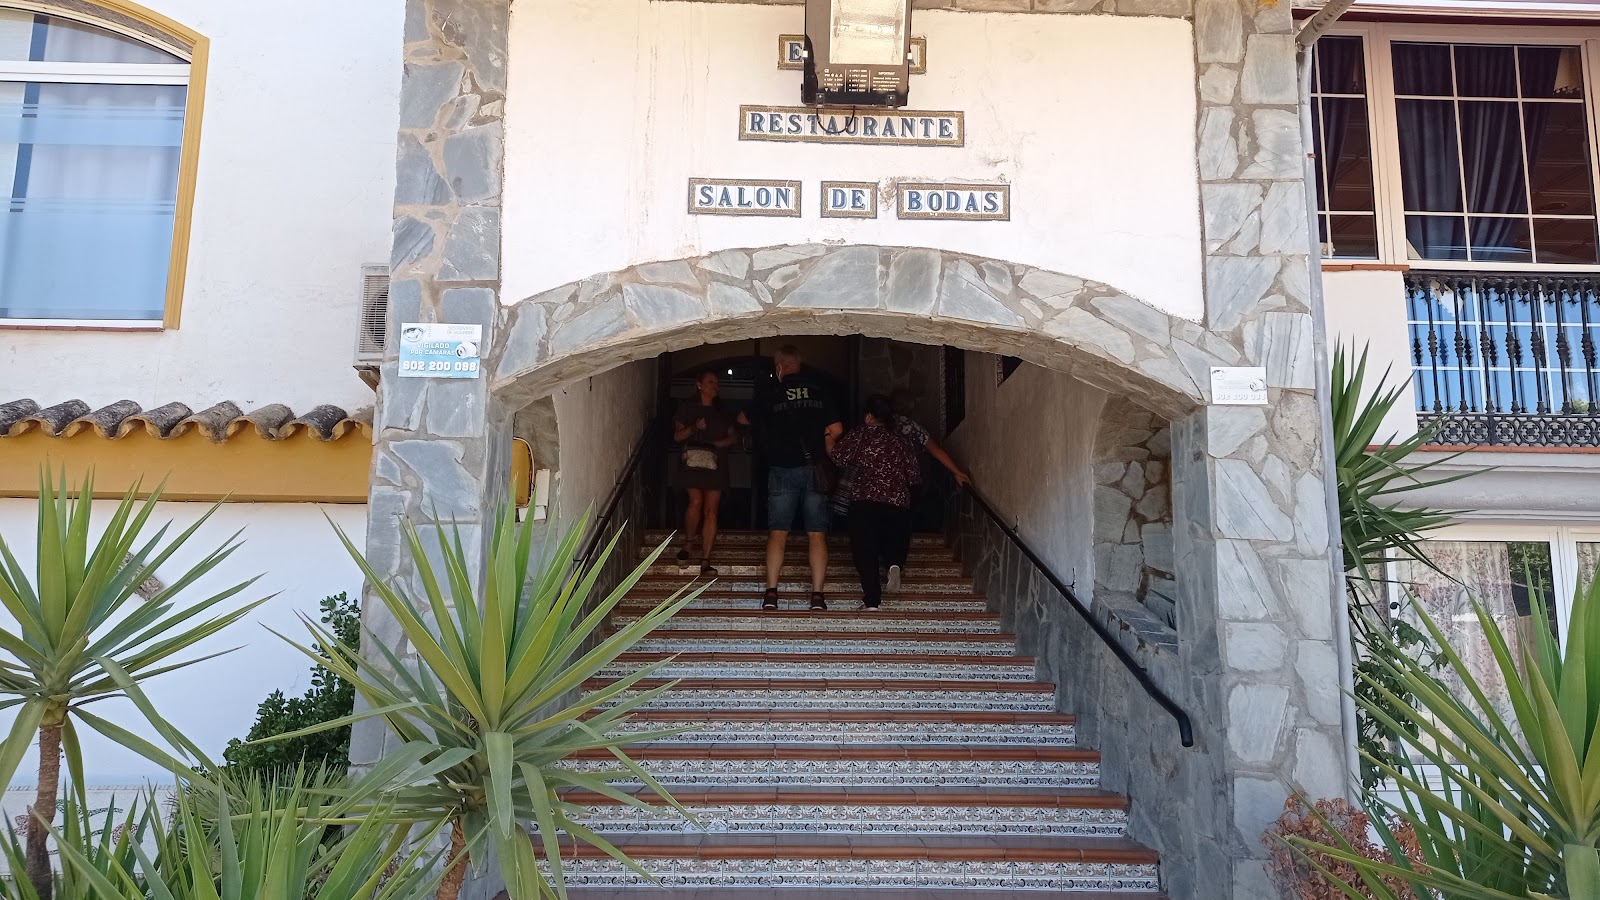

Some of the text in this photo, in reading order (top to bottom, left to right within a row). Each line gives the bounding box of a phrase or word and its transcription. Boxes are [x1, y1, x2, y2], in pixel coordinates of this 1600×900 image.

[750, 112, 953, 139] RESTAURANTE
[699, 185, 999, 213] SALON DE BODAS
[402, 360, 425, 371] 902
[428, 360, 451, 372] 200
[785, 387, 809, 400] SH
